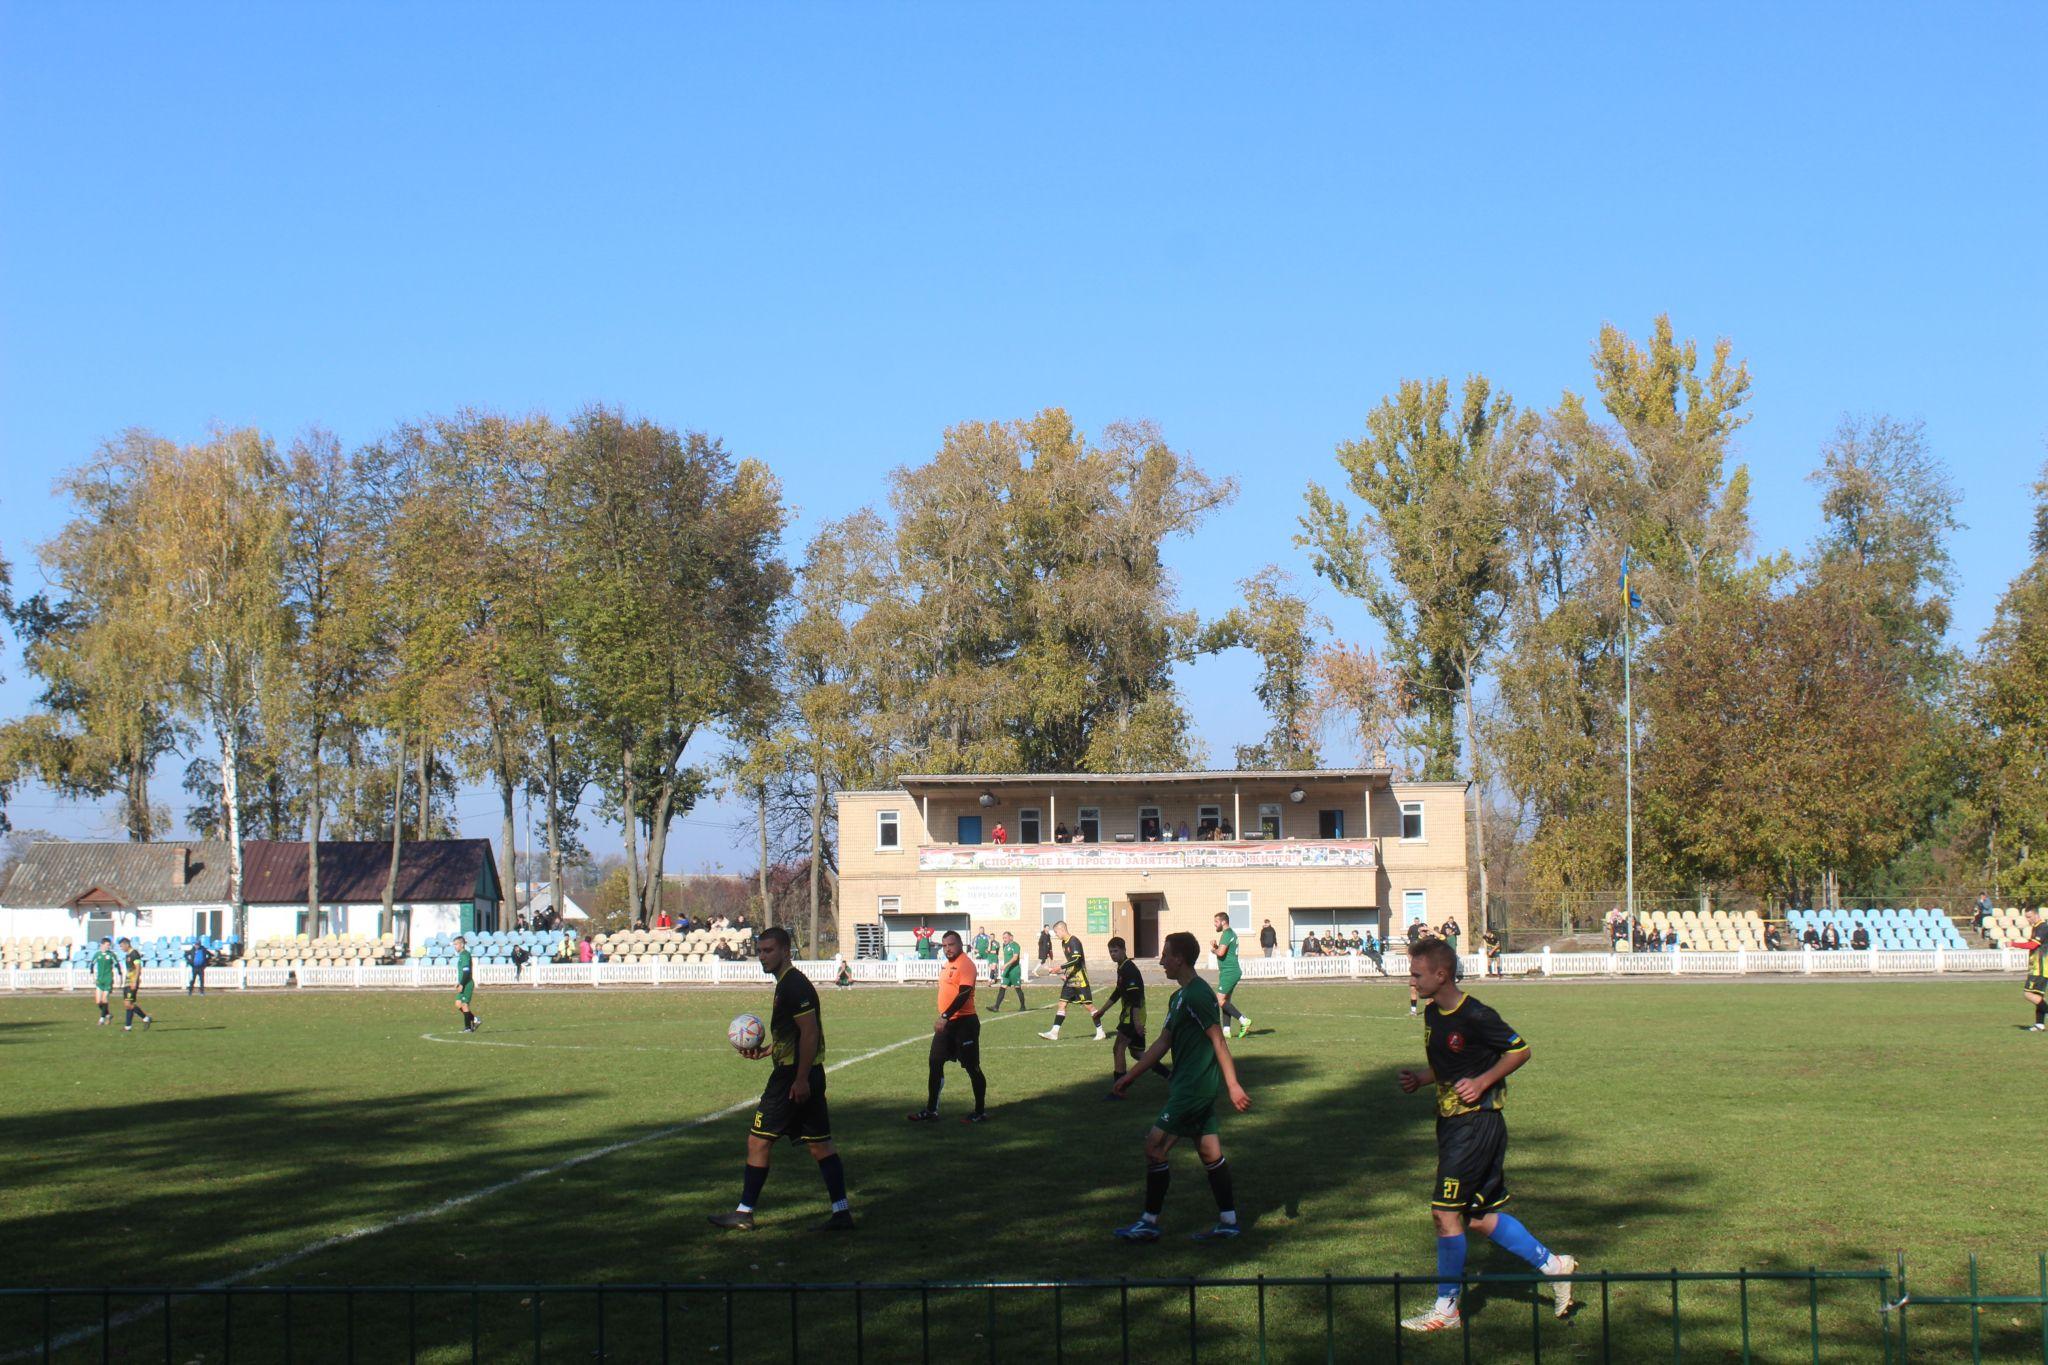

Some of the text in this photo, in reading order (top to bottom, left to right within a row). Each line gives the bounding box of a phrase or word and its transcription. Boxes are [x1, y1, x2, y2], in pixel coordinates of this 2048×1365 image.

[984, 857, 1022, 867] СПОРТ
[1037, 857, 1053, 867] ЦЕ
[1057, 857, 1073, 866] НЕ
[1077, 856, 1121, 866] ПРОСТО
[1186, 856, 1202, 865] ЦЕ
[1205, 855, 1245, 865] СТИЛЬ
[1442, 1181, 1460, 1199] 27
